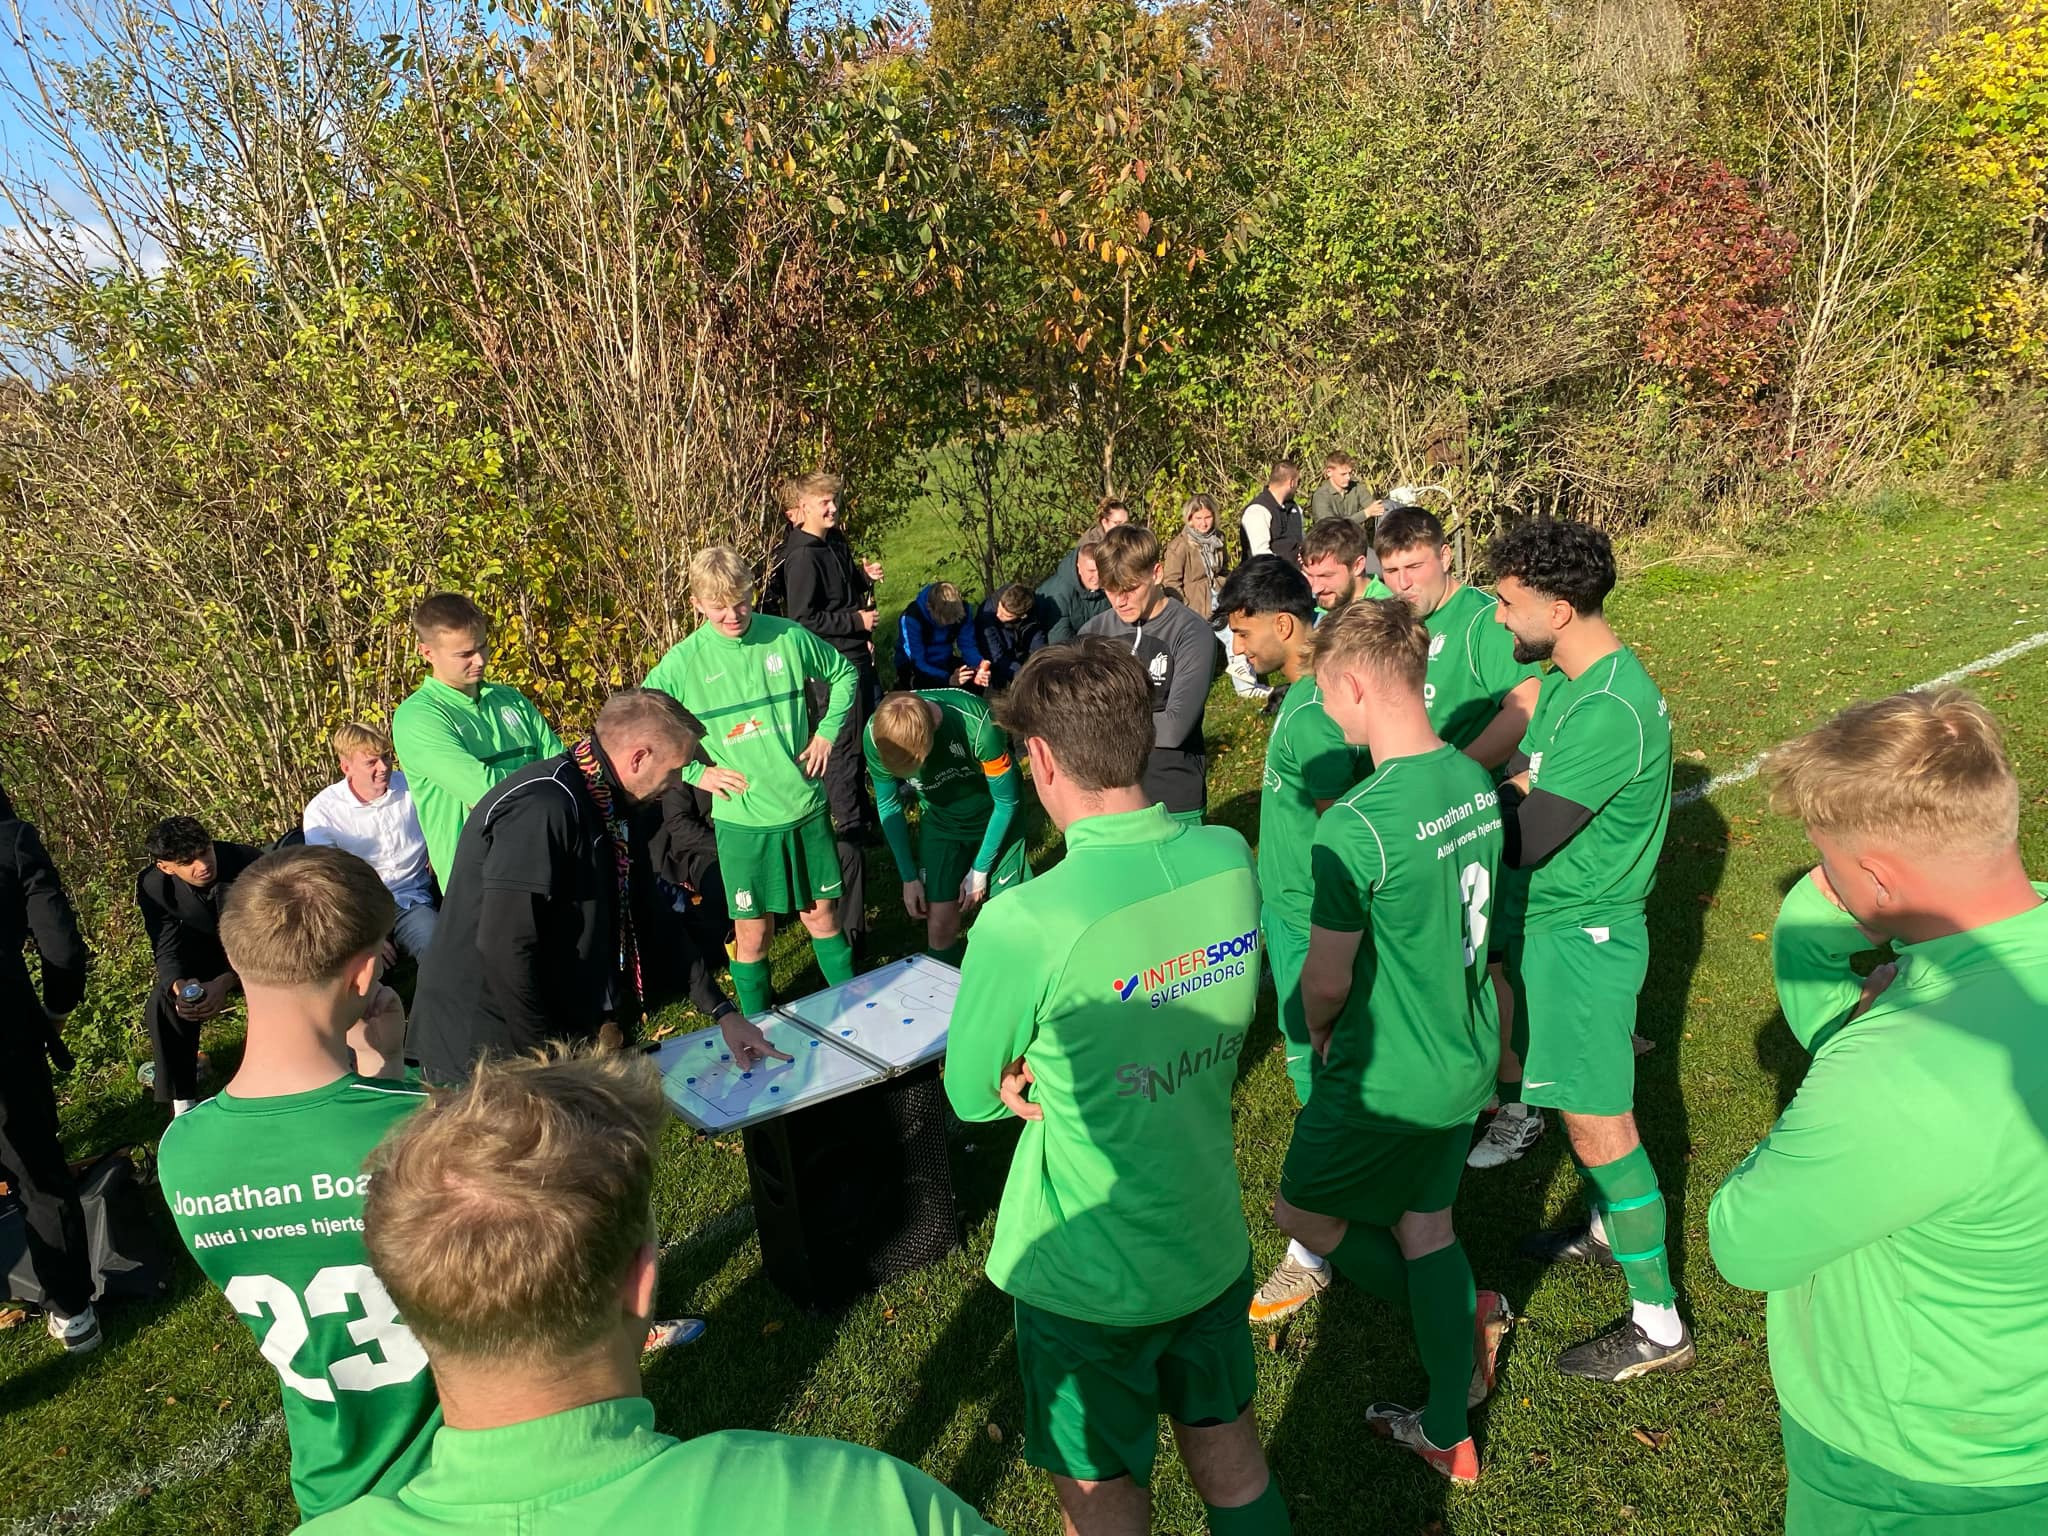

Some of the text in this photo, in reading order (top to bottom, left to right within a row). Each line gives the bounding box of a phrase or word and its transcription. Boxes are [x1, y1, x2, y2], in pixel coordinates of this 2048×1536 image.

[1416, 802, 1473, 841] Jonathan
[1142, 927, 1259, 992] INTERSPORT
[1150, 960, 1246, 1009] SVENDBORG
[1177, 1031, 1244, 1089] Anlæ
[173, 1173, 373, 1217] Jonathan Boa
[193, 1216, 366, 1249] Altid i vores hjerte
[223, 1263, 430, 1403] 23
